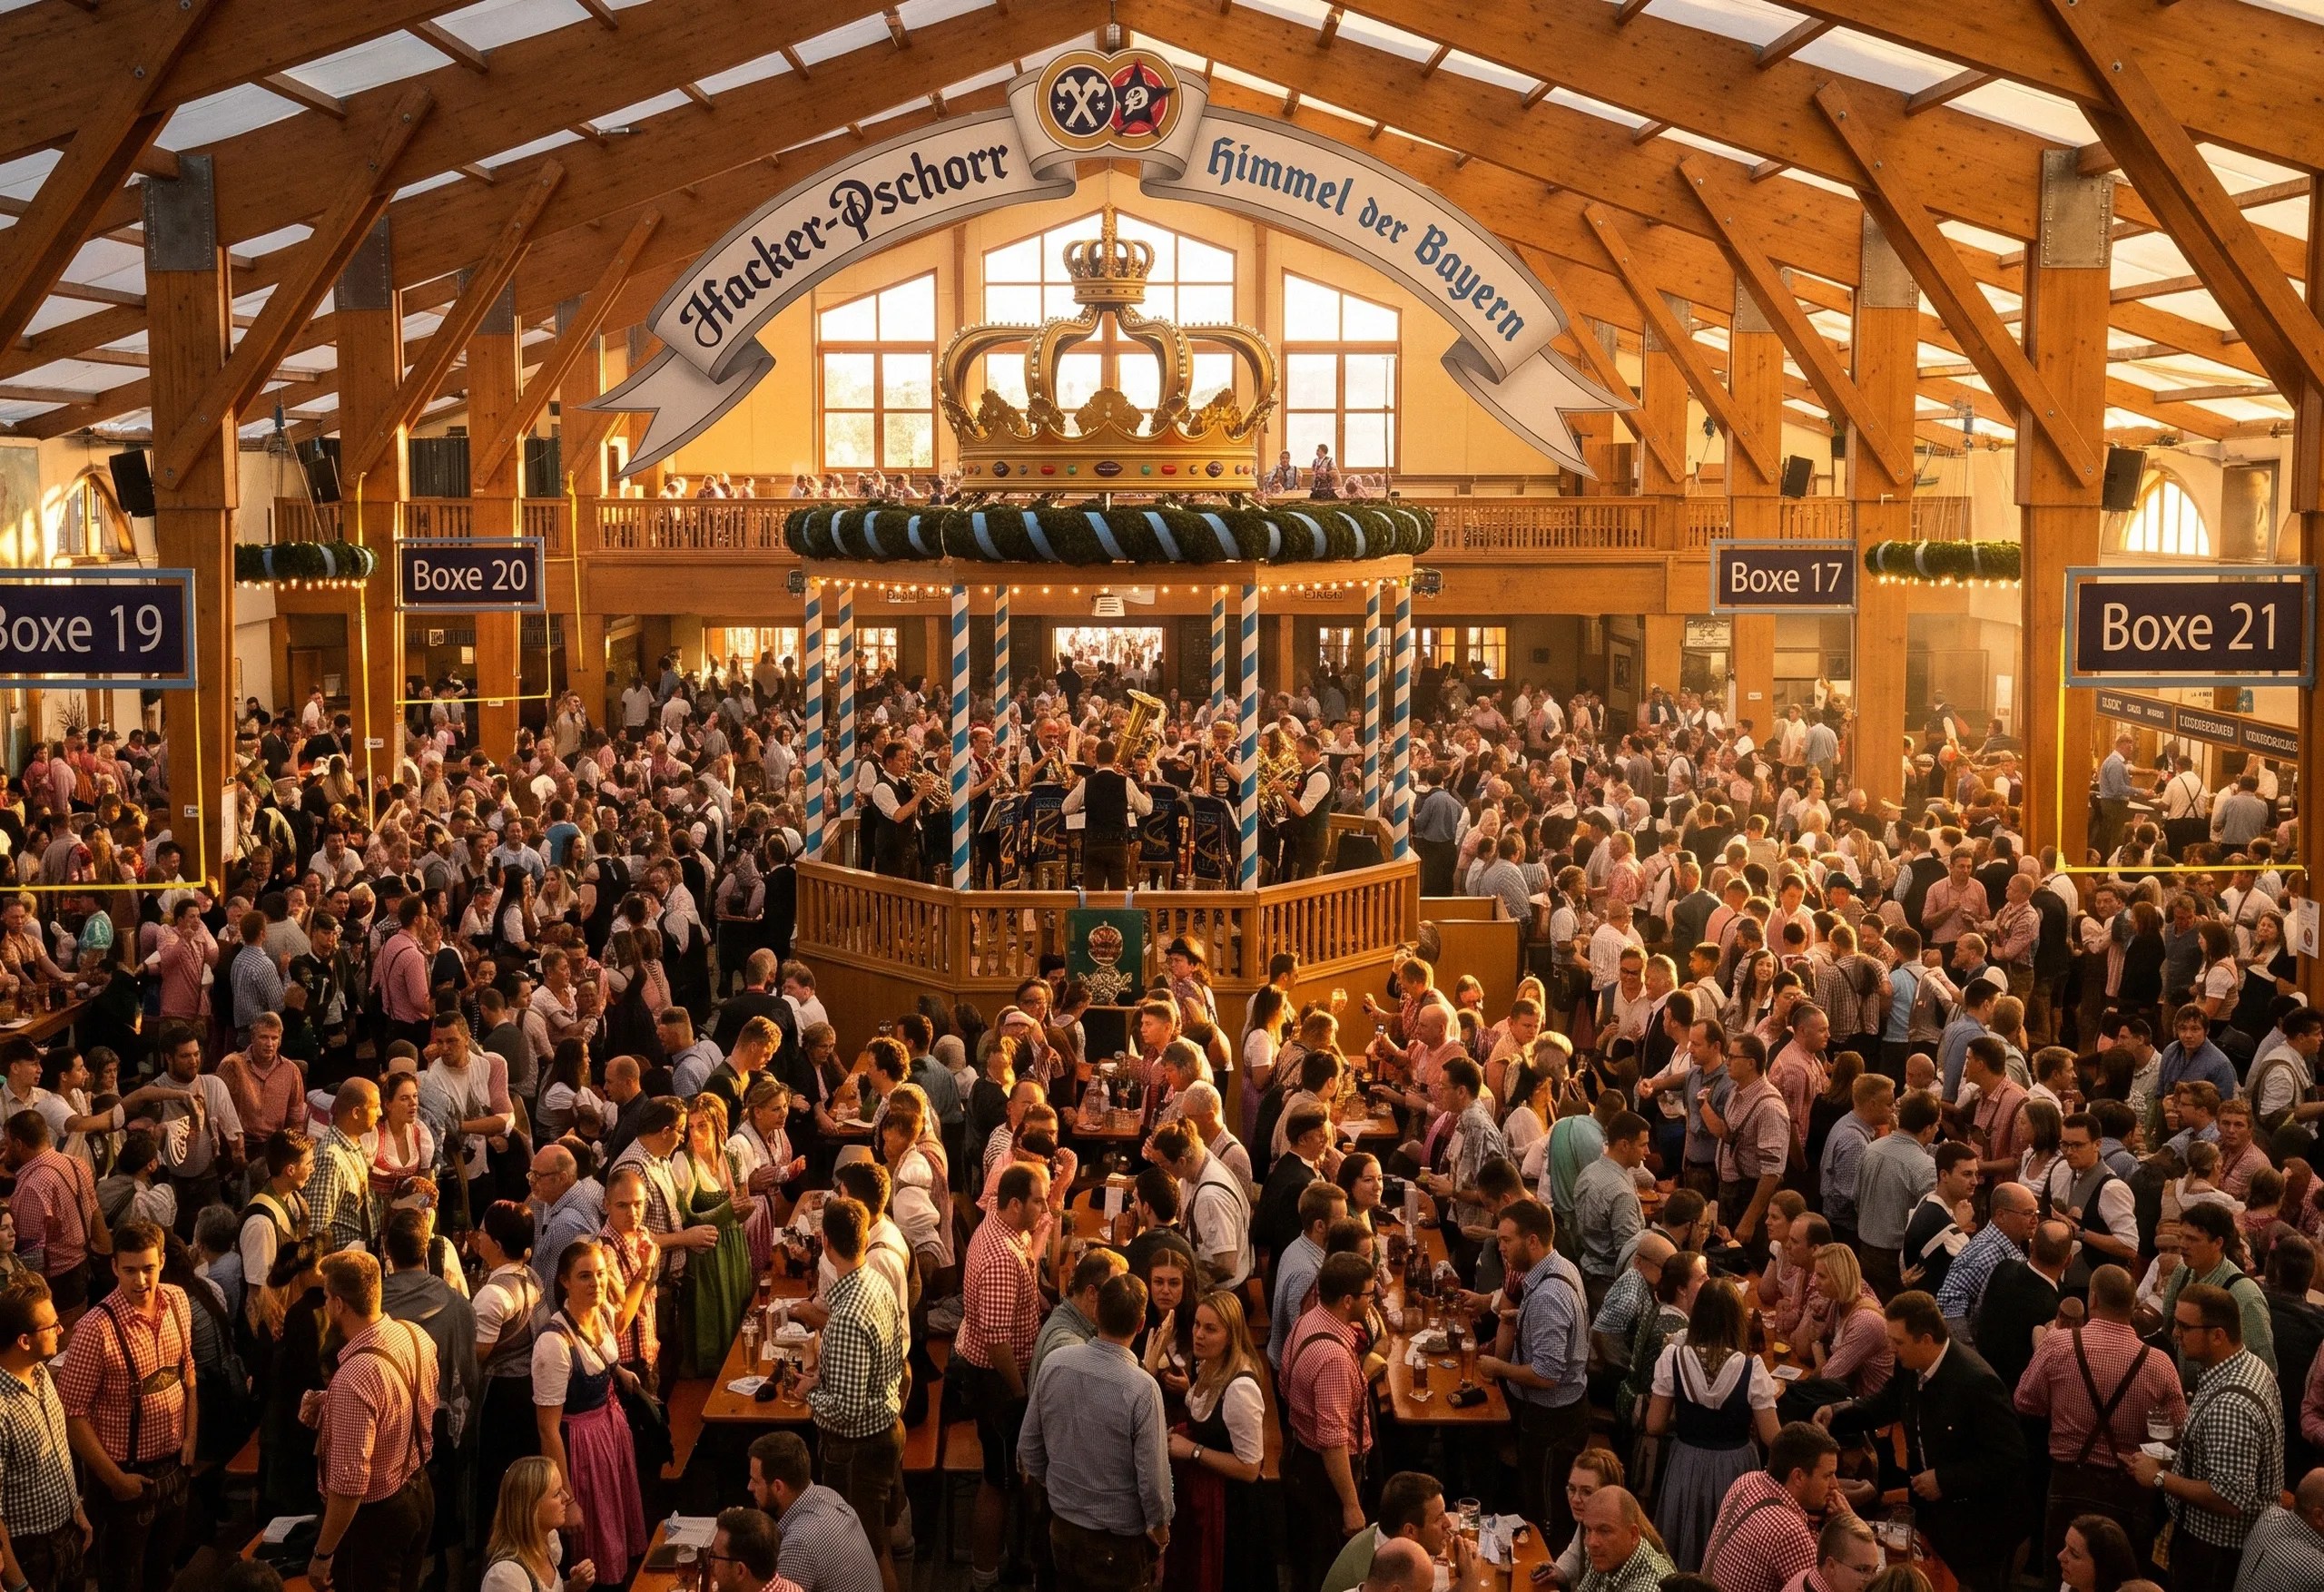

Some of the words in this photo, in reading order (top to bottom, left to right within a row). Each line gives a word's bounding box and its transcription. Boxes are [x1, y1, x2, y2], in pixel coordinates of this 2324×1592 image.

[679, 142, 1009, 348] Hacker-Pschorr
[1207, 137, 1354, 216] Himmel
[1358, 197, 1408, 244] der
[1414, 224, 1525, 342] Bayern
[414, 560, 483, 590] Boxe
[491, 560, 527, 590] 20
[1731, 562, 1800, 593] Boxe
[1811, 563, 1843, 593] 17
[110, 604, 162, 653] 19
[2102, 603, 2213, 651] Boxe
[2229, 603, 2276, 650] 21
